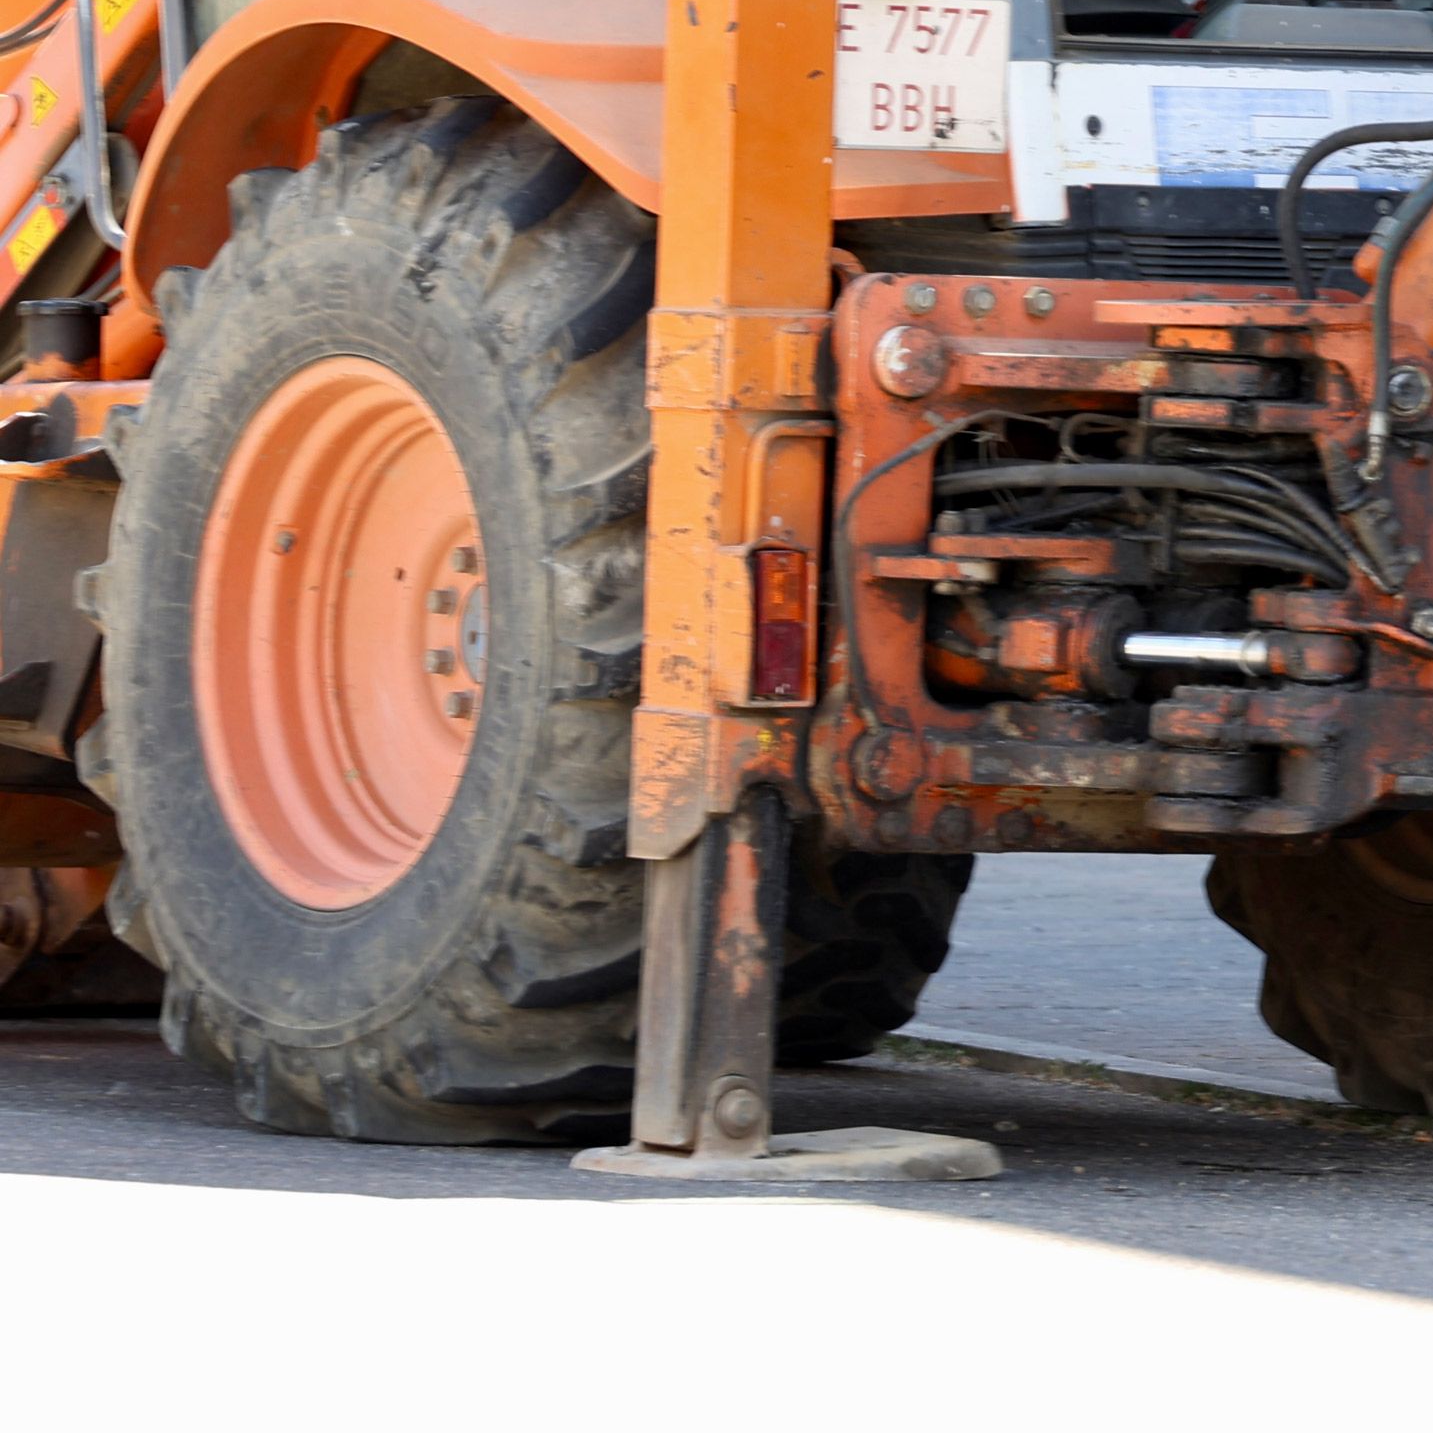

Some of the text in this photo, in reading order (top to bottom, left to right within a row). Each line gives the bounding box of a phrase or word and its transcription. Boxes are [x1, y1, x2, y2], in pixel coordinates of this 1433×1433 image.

[837, 3, 993, 57] E 7577
[869, 82, 958, 135] BBH
